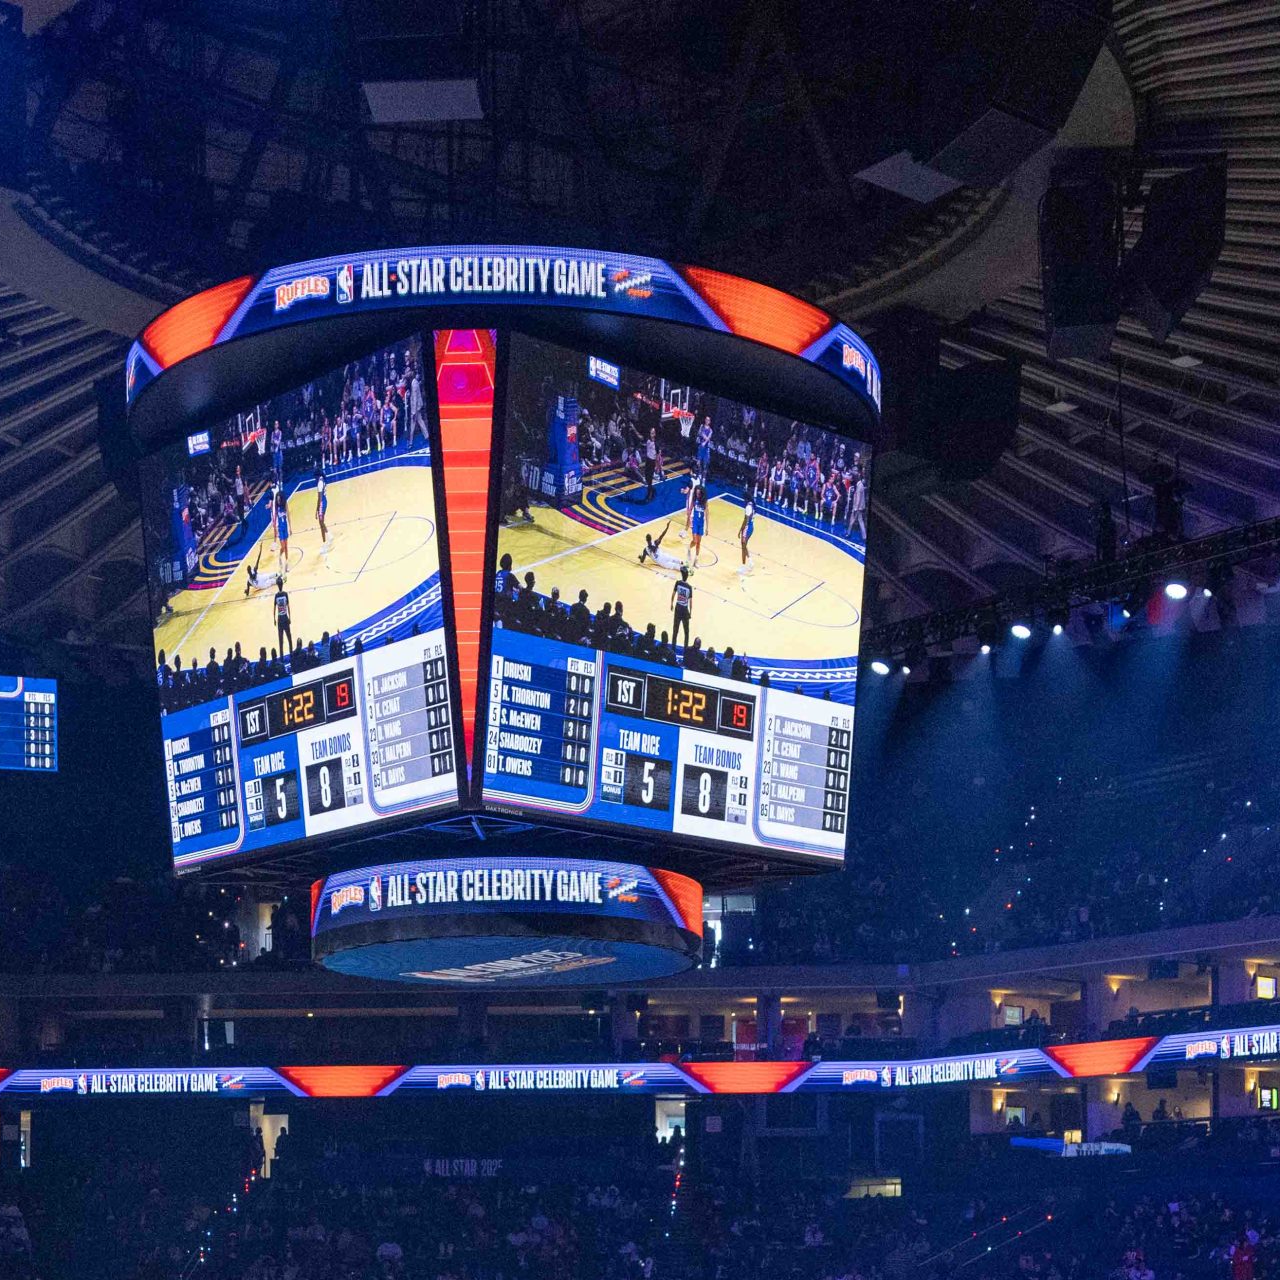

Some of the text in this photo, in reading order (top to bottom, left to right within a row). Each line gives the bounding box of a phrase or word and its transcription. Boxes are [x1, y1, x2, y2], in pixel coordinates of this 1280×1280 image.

[276, 274, 329, 310] RUFFLES
[450, 256, 551, 294] CELEBRITY
[553, 258, 607, 298] GAME
[504, 660, 531, 682] DRUSKI
[335, 683, 349, 707] 19
[494, 686, 499, 698] 5
[512, 687, 551, 709] THORNTON
[617, 680, 636, 705] 1ST
[667, 687, 706, 722] 1:22
[283, 691, 314, 725] 1:22
[492, 710, 497, 722] 5
[501, 708, 508, 724] S.
[733, 704, 747, 727] 19
[246, 710, 260, 734] 1ST
[768, 718, 773, 731] 2
[489, 731, 542, 755] 24 SHABOOZEY
[620, 729, 660, 755] TEAM RICE
[767, 740, 770, 752] 3
[487, 752, 495, 765] 81
[506, 756, 532, 776] OWENS
[694, 744, 742, 771] TEAM BONDS
[764, 761, 771, 774] 23
[642, 761, 655, 804] 5
[698, 772, 712, 814] 8
[762, 782, 769, 795] 33
[331, 885, 364, 914] RUFFLES
[462, 869, 554, 902] CELEBRITY
[557, 871, 603, 904] GAME
[1186, 1041, 1217, 1060] RUFFLES
[41, 1077, 74, 1093] RUFFLES
[138, 1073, 190, 1093] CELEBRITY
[190, 1073, 219, 1093] GAME
